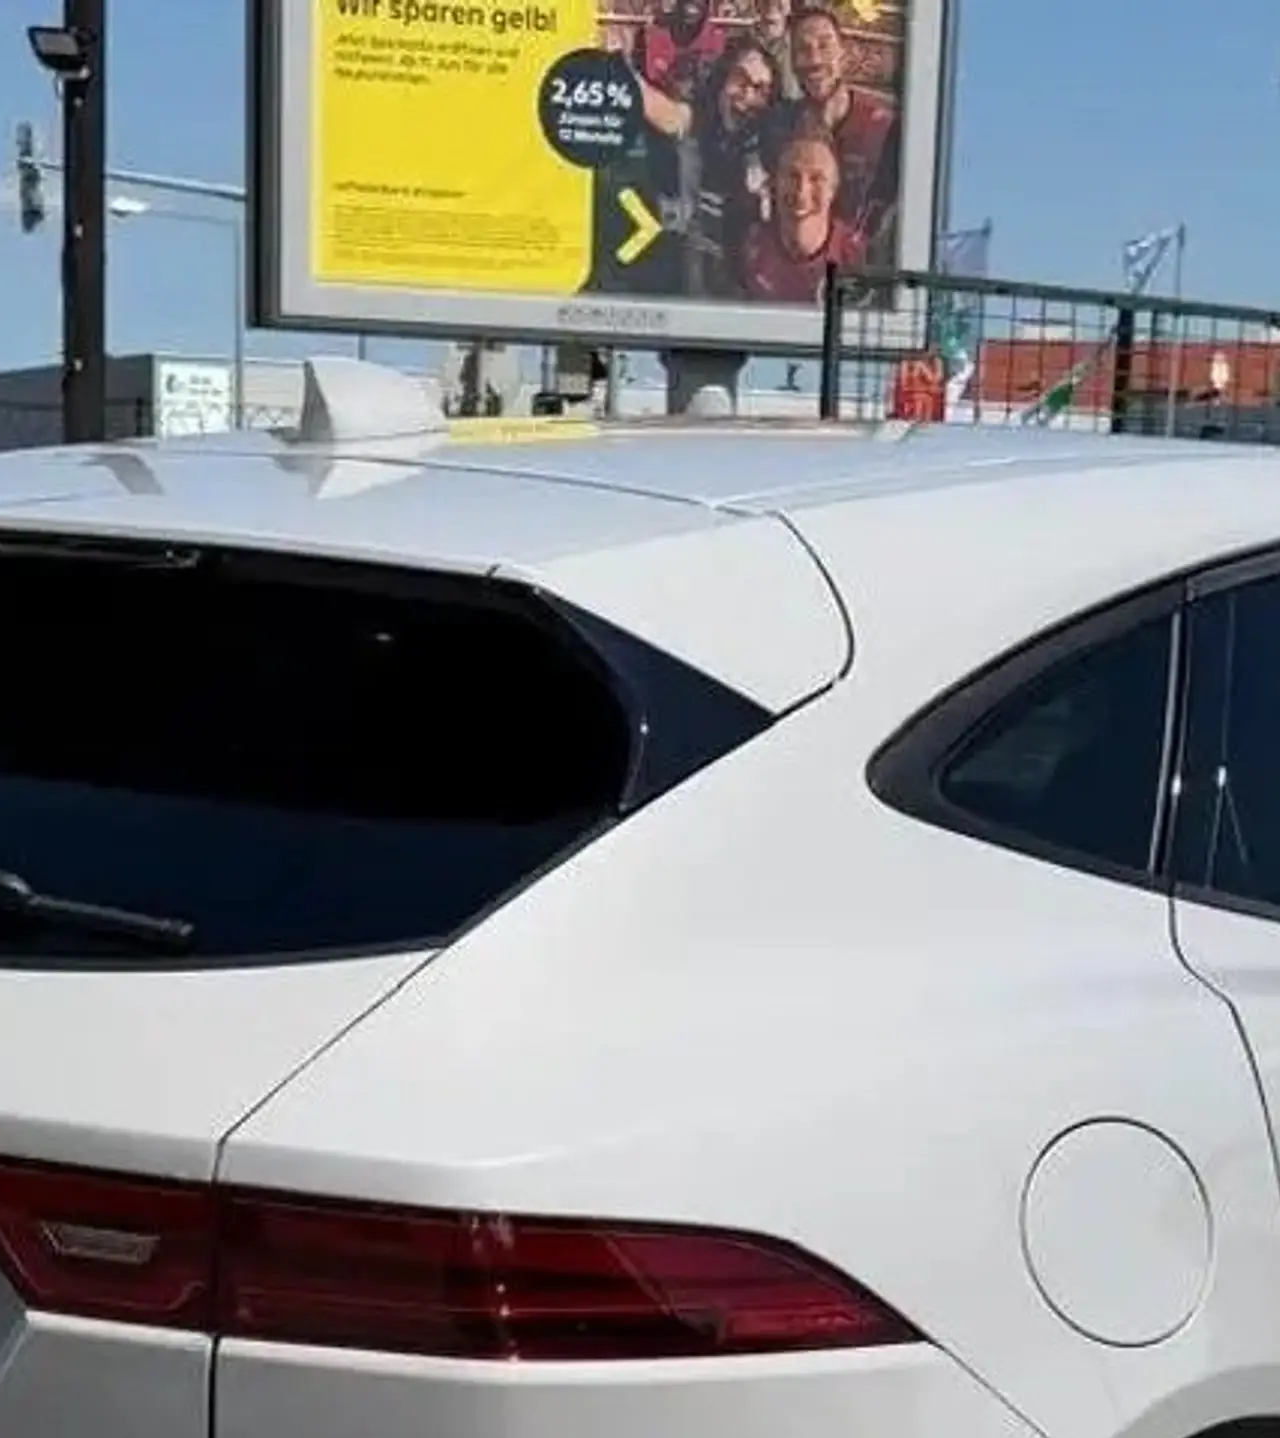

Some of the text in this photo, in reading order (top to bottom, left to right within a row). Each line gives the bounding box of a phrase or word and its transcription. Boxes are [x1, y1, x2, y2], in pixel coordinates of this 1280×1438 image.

[336, 0, 558, 33] Wir sparen gelb!
